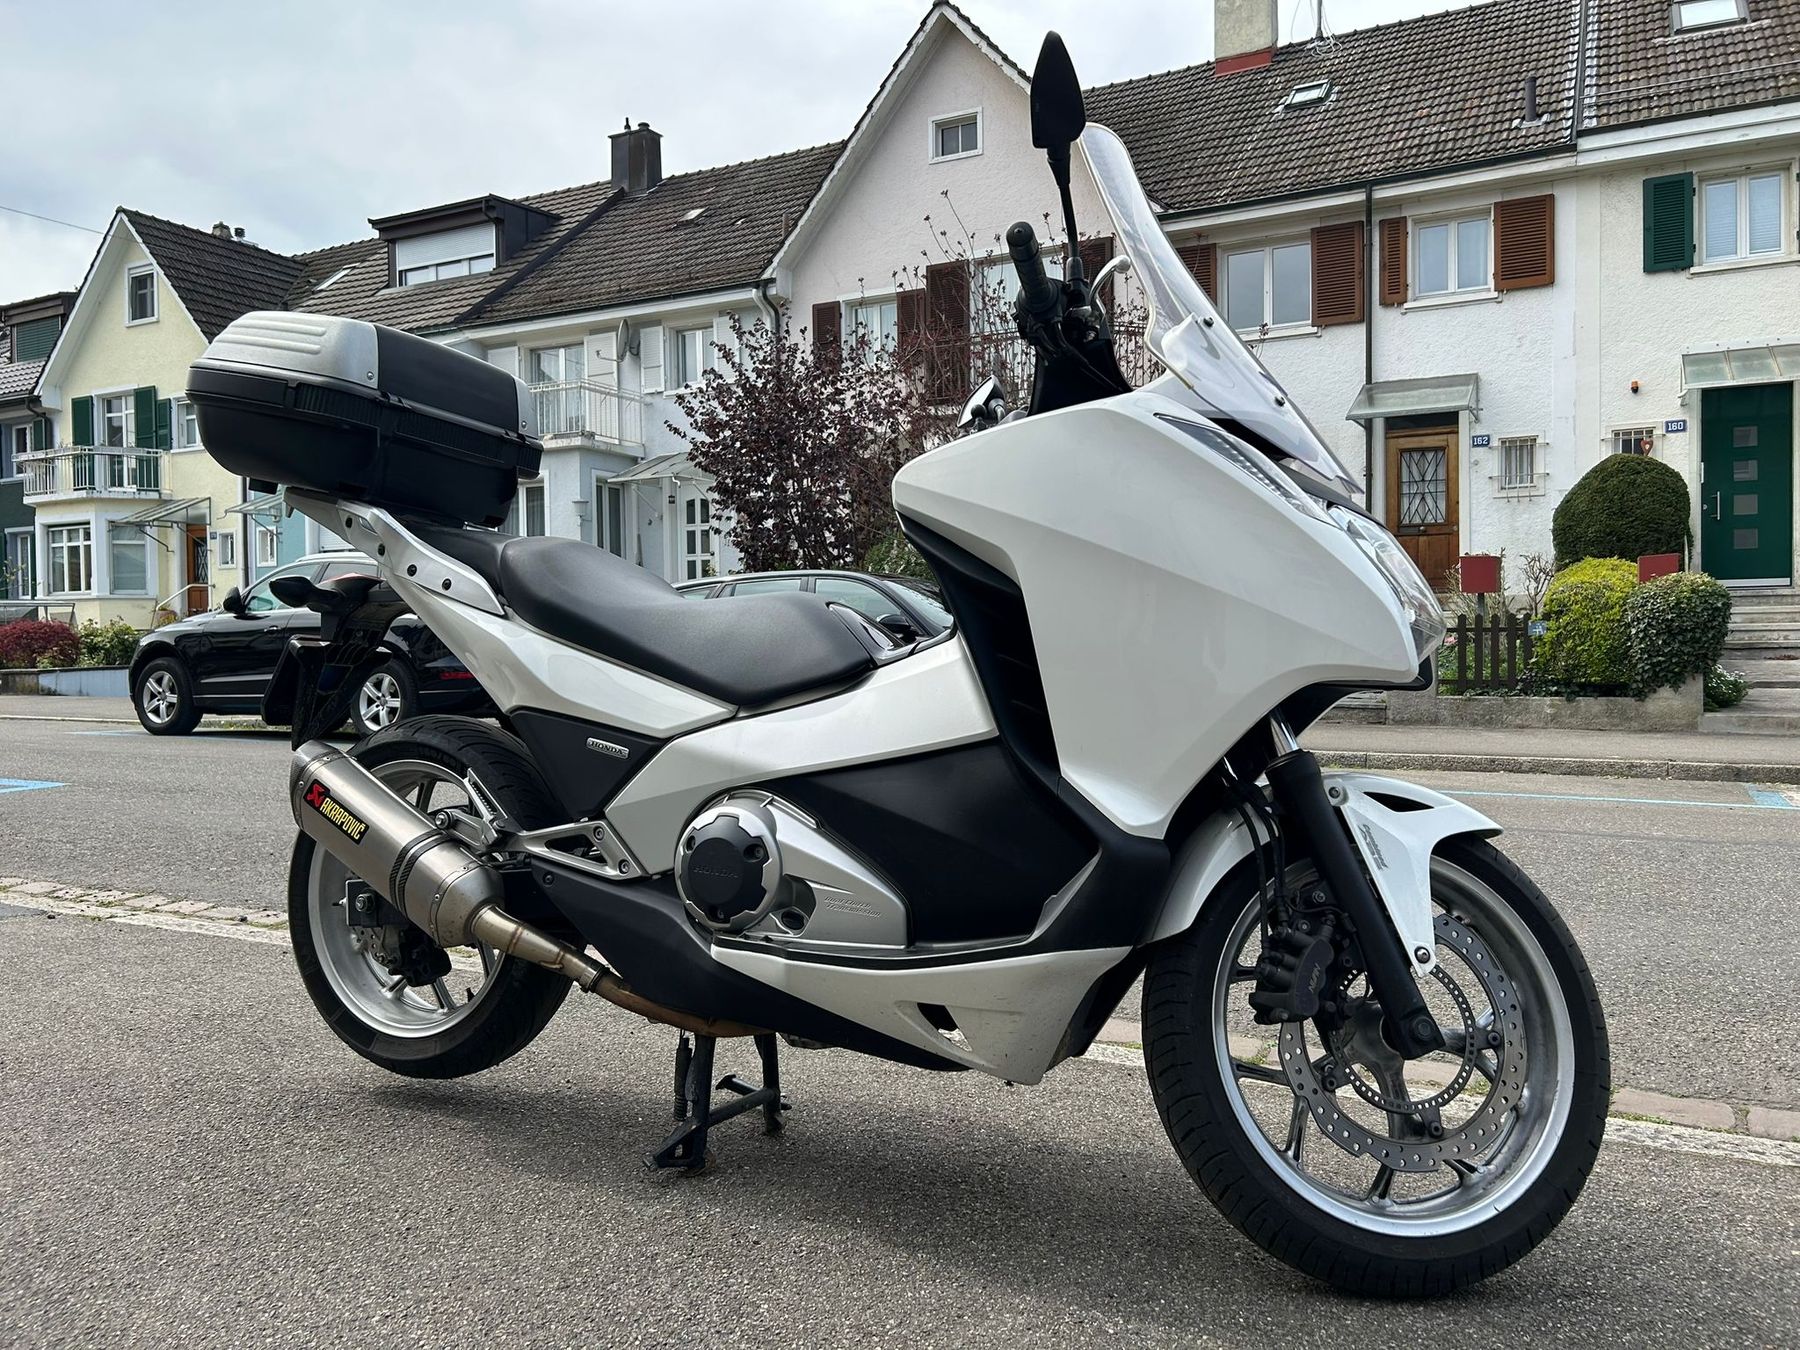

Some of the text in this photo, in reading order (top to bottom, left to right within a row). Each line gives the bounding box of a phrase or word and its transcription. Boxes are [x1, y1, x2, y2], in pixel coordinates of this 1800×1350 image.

[1668, 422, 1684, 431] 160
[1473, 436, 1489, 445] 162
[591, 740, 624, 755] HONDA
